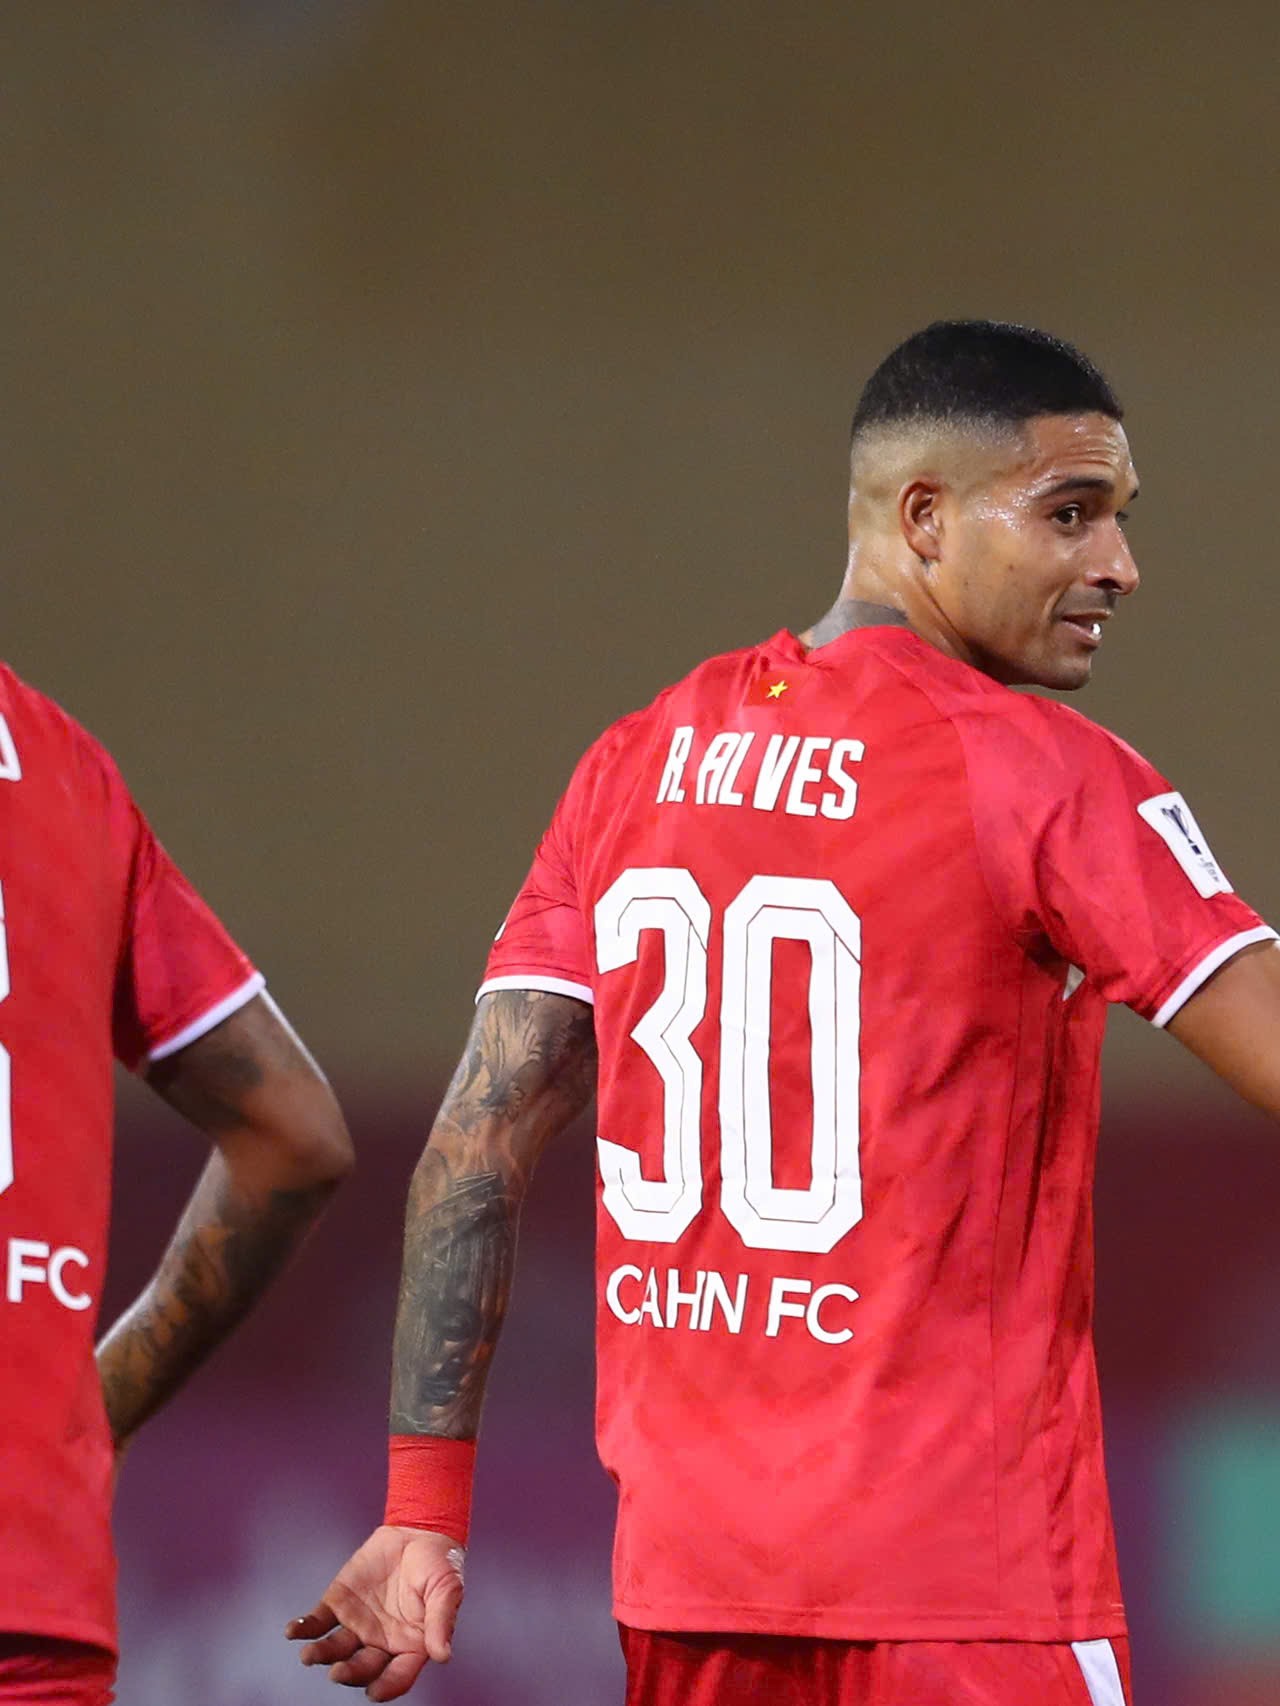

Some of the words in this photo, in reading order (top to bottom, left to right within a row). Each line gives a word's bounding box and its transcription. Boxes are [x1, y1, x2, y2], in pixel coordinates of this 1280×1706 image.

[695, 731, 865, 820] ALVES
[594, 867, 863, 1253] 30
[7, 1238, 92, 1311] FC
[606, 1265, 748, 1333] CAHN
[765, 1277, 860, 1344] FC
